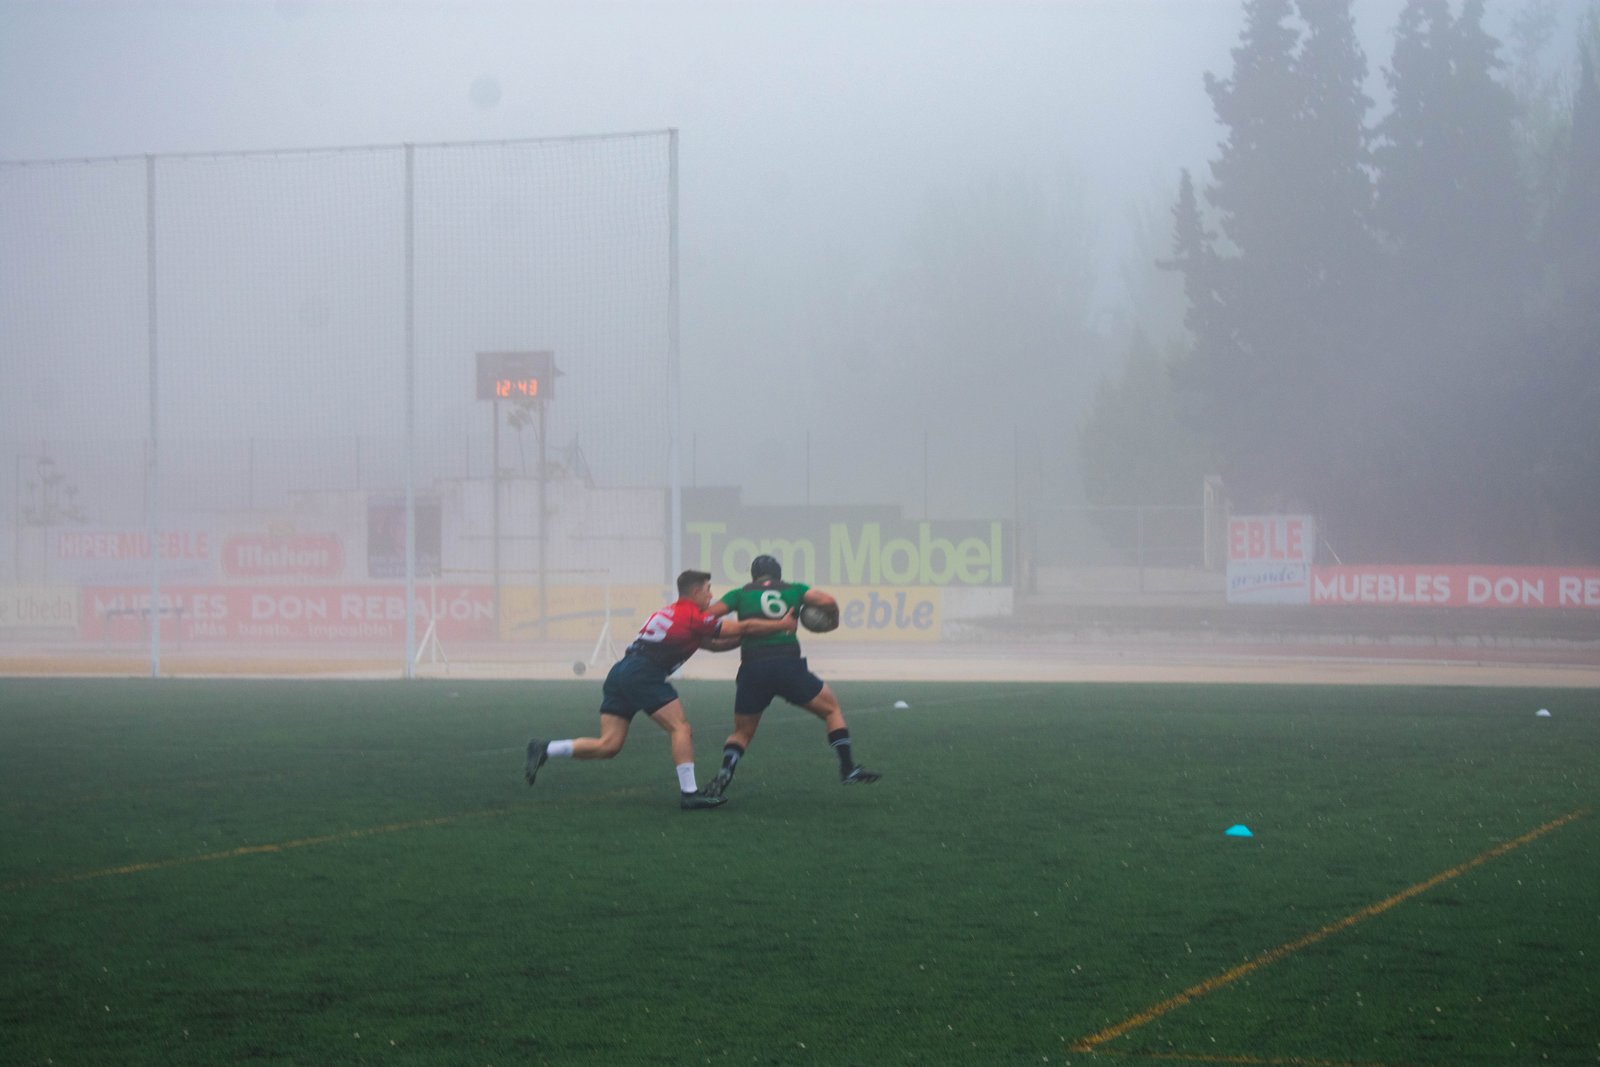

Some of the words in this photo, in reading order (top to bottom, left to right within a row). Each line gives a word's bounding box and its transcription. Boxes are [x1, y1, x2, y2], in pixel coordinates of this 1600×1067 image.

[496, 378, 538, 397] 12:43
[686, 521, 815, 586] Tom
[830, 521, 1004, 585] Mobel
[1230, 519, 1304, 559] EBLE
[94, 594, 228, 620] MUEBLES
[251, 594, 327, 620] DON
[340, 588, 494, 622] REBAJÓN
[760, 590, 787, 618] 6
[1314, 574, 1450, 602] MUEBLES
[1467, 577, 1545, 605] DON
